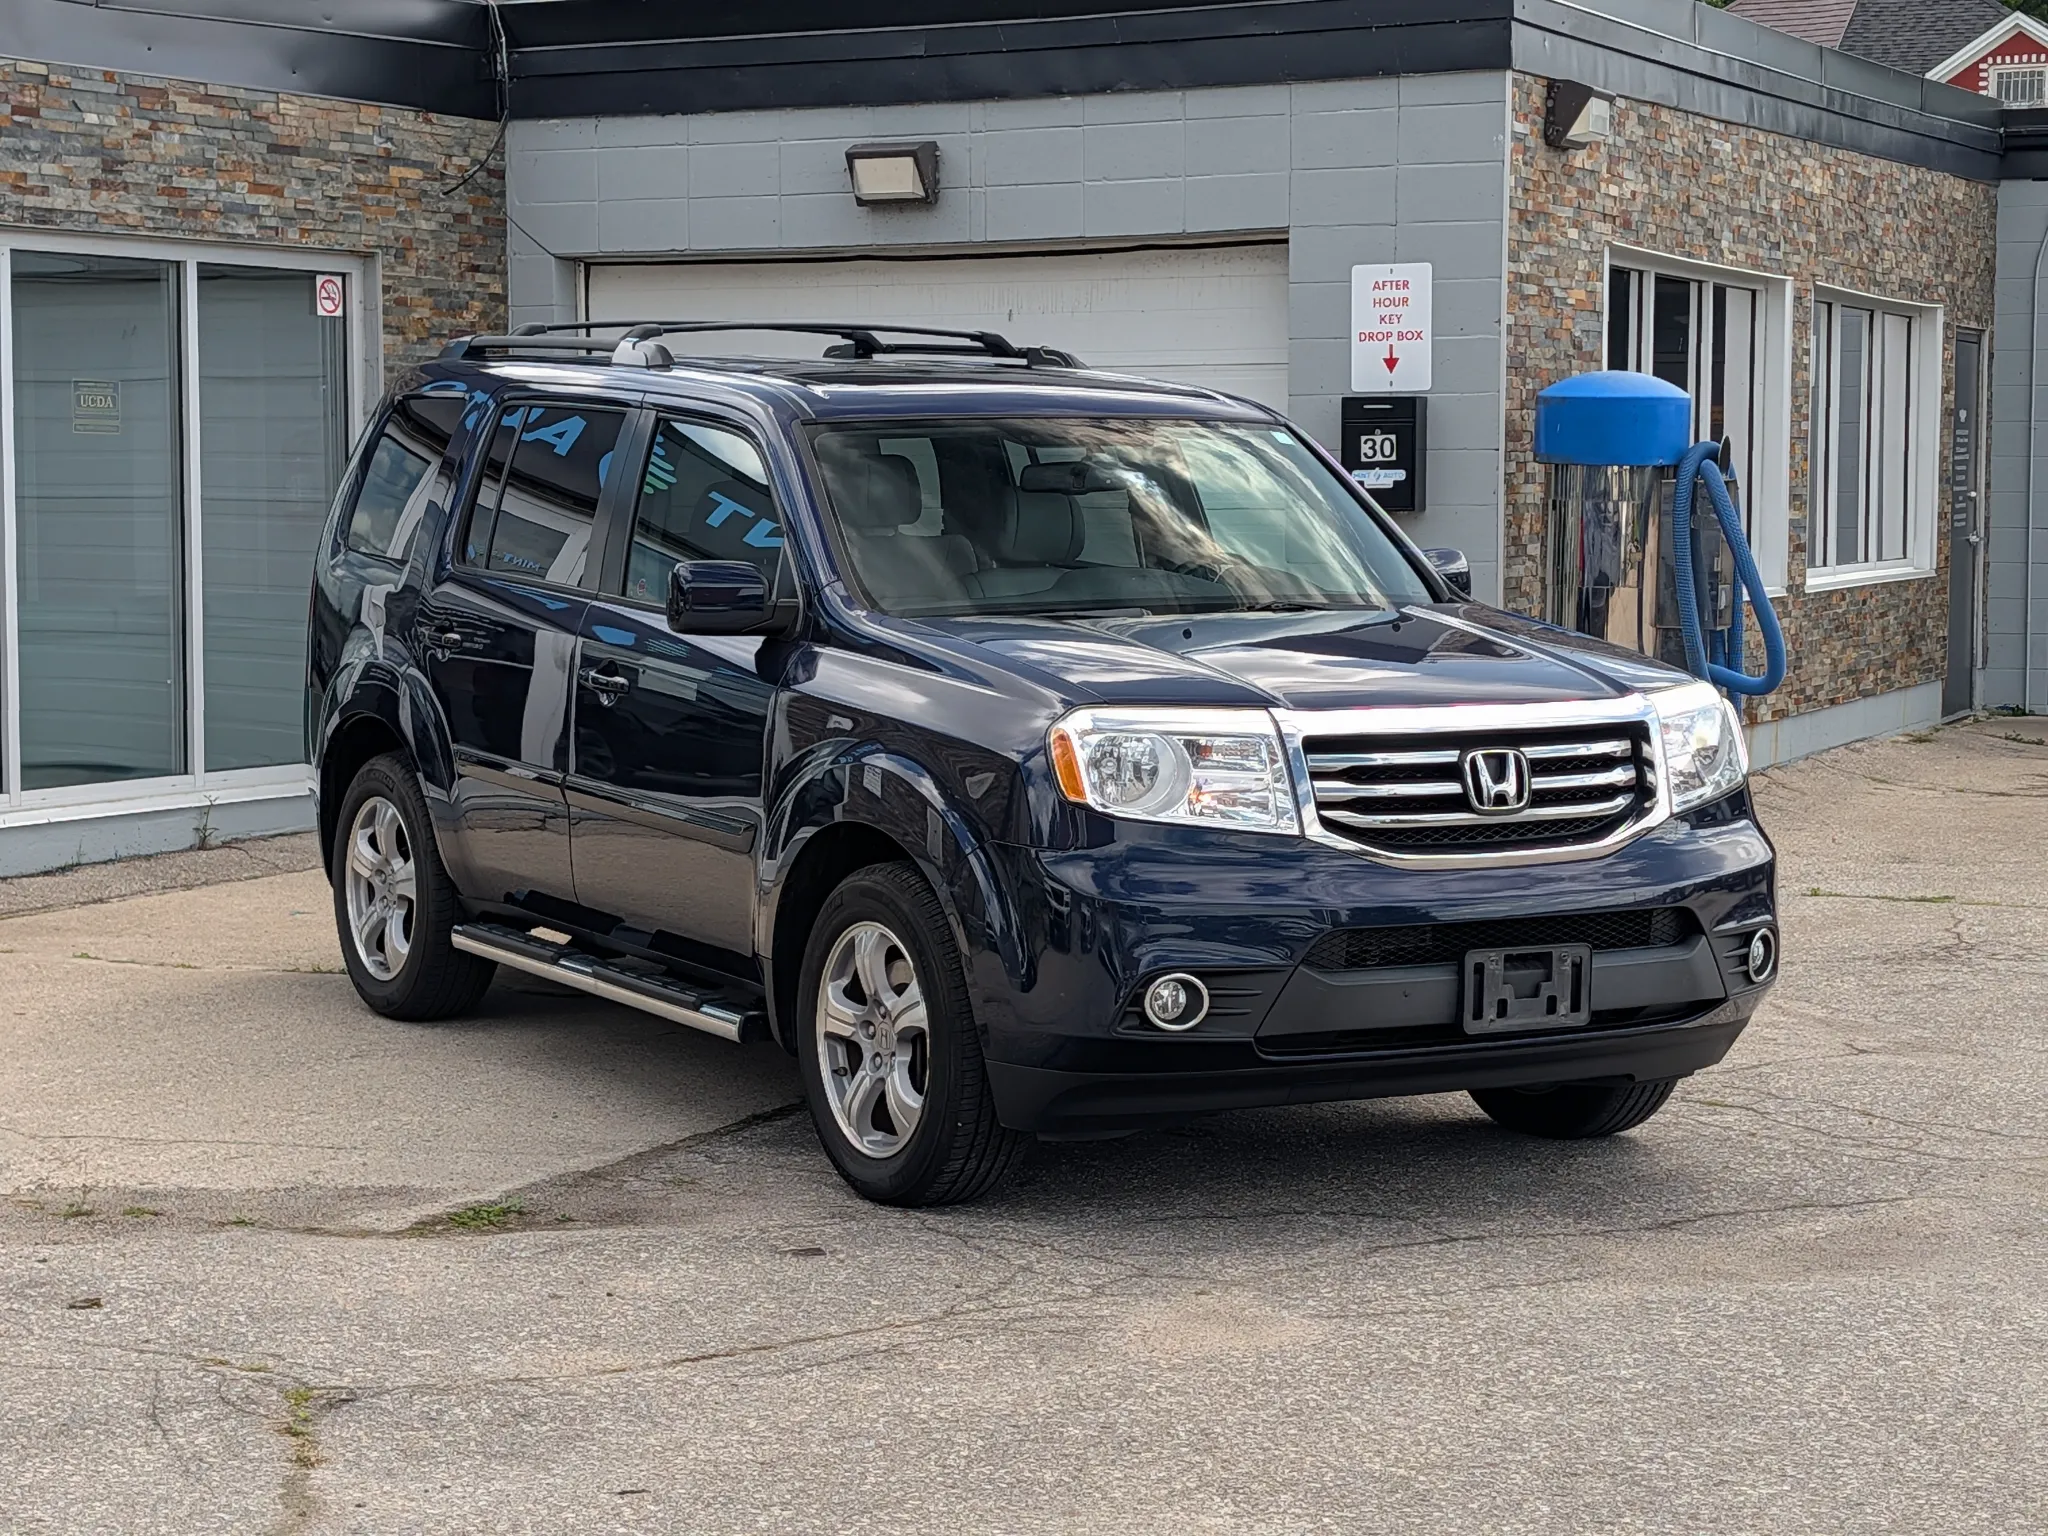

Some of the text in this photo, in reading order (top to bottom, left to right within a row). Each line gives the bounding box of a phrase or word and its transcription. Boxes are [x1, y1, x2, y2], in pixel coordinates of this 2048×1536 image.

[1372, 280, 1410, 292] AFTER
[1373, 296, 1409, 308] HOUR
[1379, 313, 1403, 325] KEY
[1359, 330, 1424, 343] DROP BOX
[80, 394, 114, 408] UCDA
[1362, 437, 1396, 459] 30
